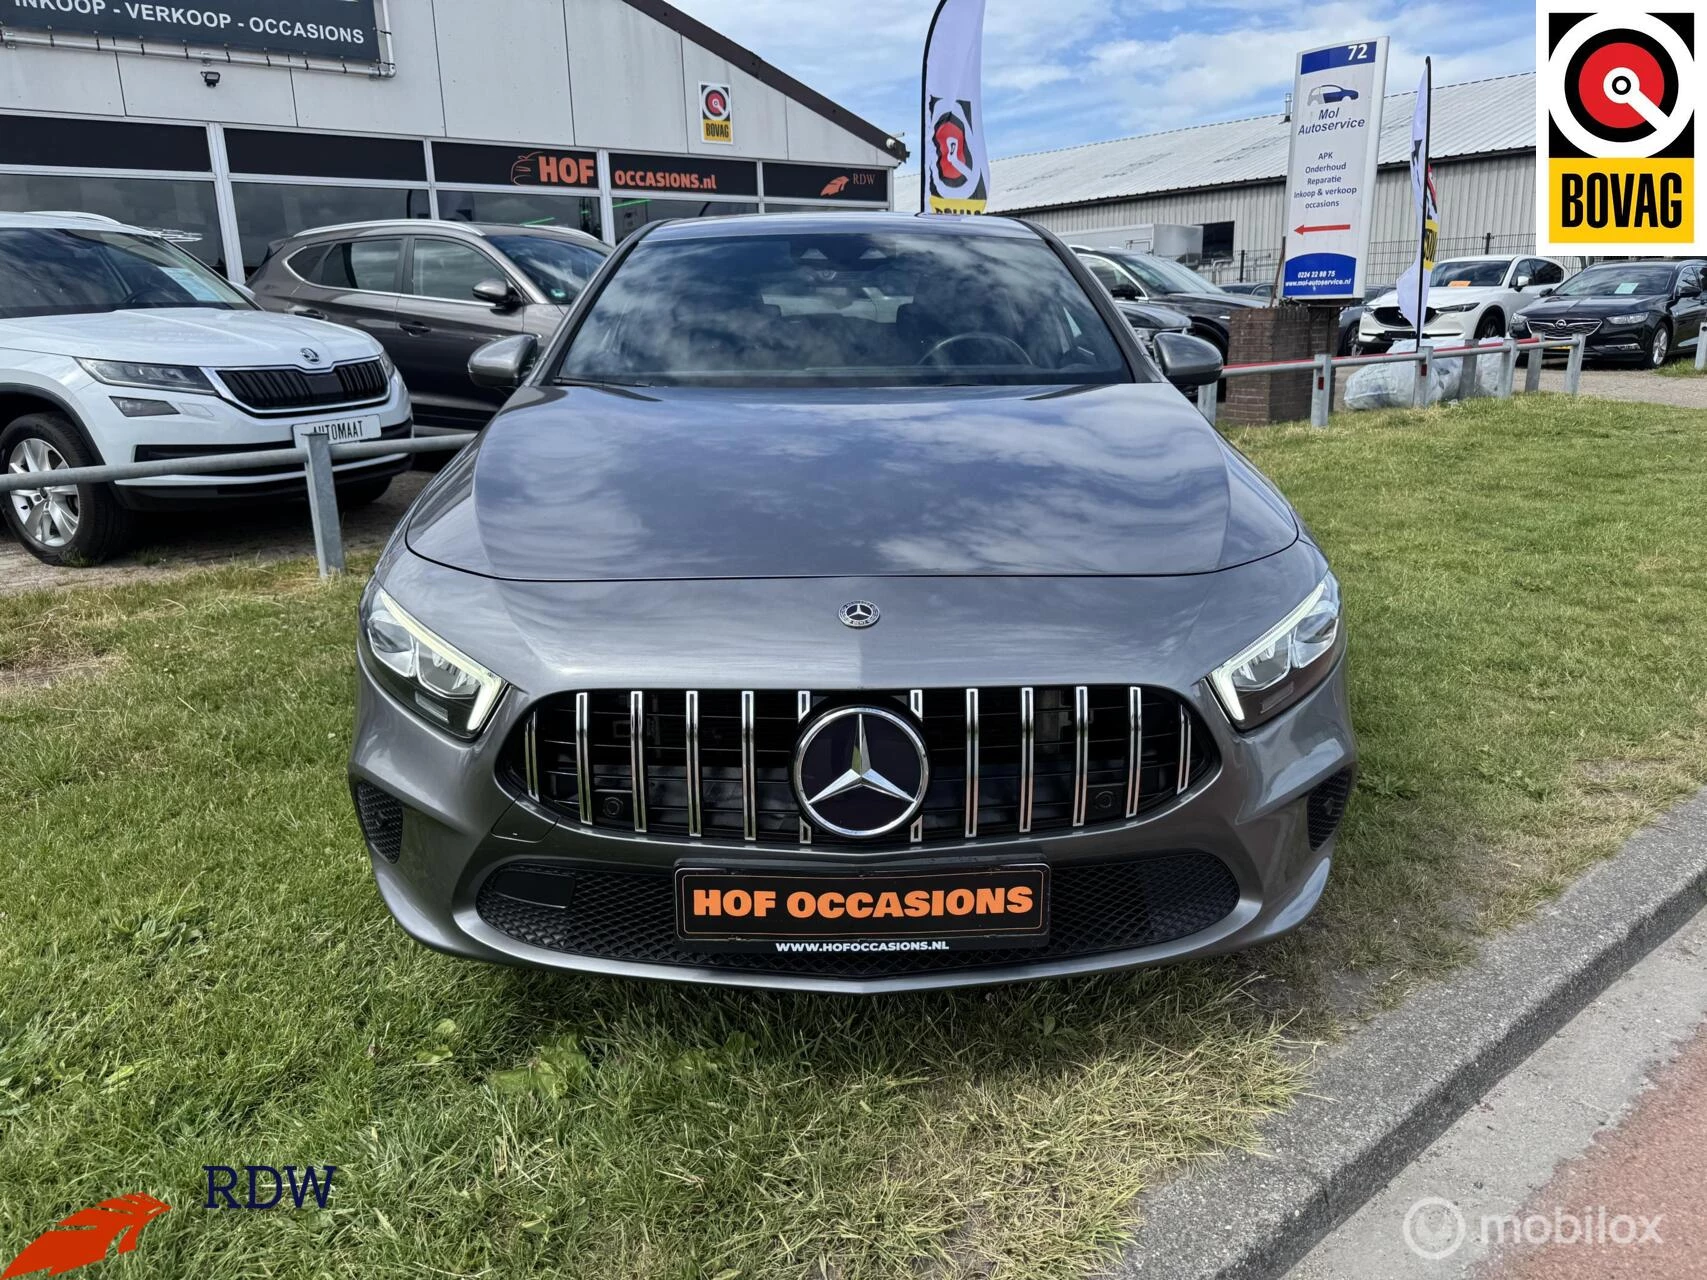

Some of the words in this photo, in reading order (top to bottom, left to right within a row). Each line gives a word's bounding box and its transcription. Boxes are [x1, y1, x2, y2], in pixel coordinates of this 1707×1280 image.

[125, 2, 231, 29] VERKOOP
[250, 16, 364, 44] OCCASIONS
[1348, 43, 1368, 61] 72
[1318, 107, 1340, 121] Mol
[705, 122, 730, 139] BOVAG
[1298, 117, 1365, 135] Autoservice
[1318, 151, 1334, 160] APK
[538, 156, 594, 185] HOF
[1305, 162, 1347, 174] Onderhoud
[614, 169, 717, 190] OCCASIONS.nl
[852, 173, 876, 185] RDW
[1307, 176, 1342, 186] Reparatie
[1317, 188, 1323, 196] &
[1325, 186, 1358, 195] verkoop
[1305, 200, 1340, 209] occasions
[693, 889, 776, 917] HOF
[786, 886, 1034, 918] OCCASIONS
[776, 940, 949, 953] WWW.HOFOCCASIONS.NL
